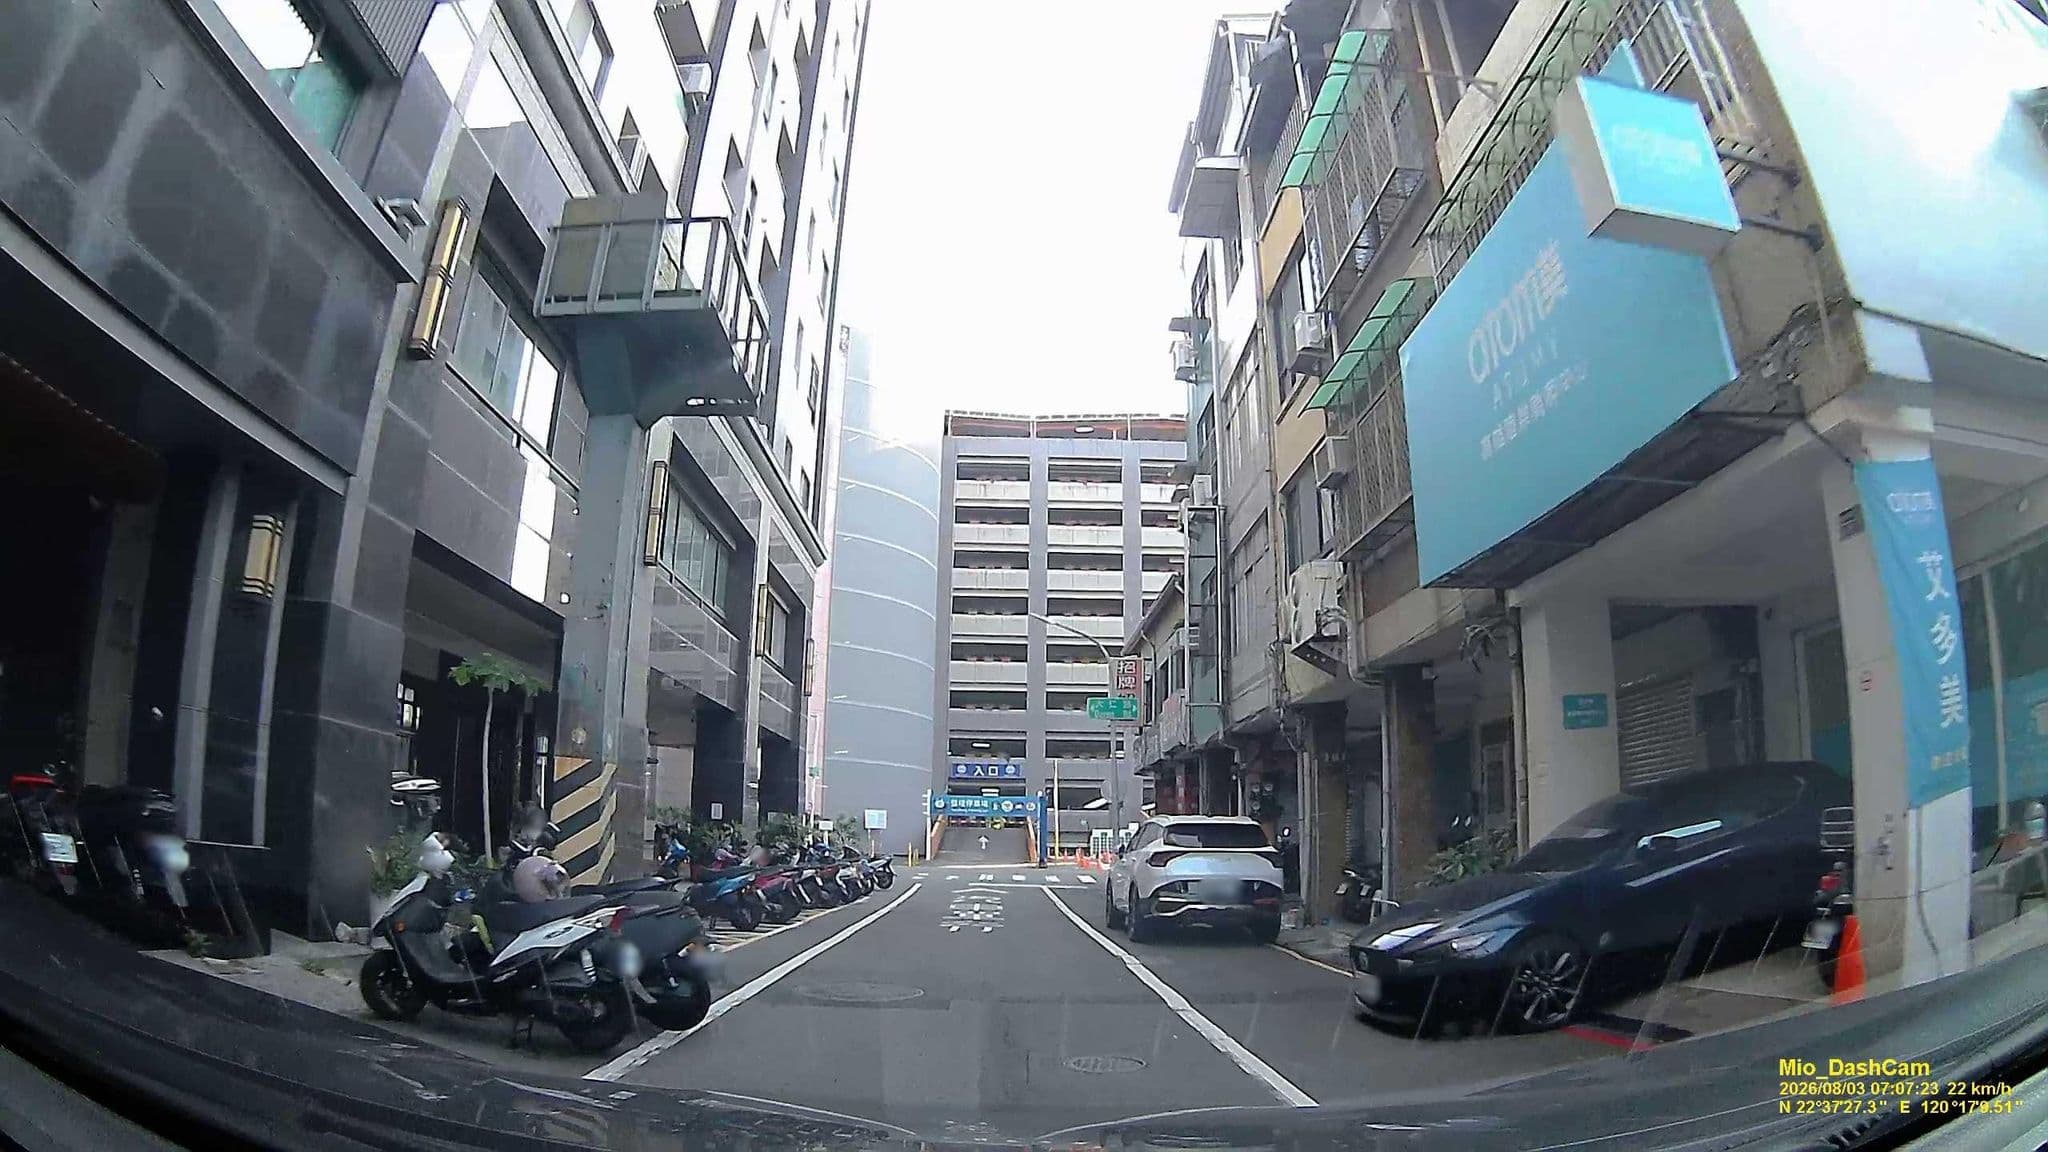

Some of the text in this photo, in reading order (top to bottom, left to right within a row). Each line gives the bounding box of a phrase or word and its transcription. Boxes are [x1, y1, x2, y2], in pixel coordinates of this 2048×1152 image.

[1916, 550, 1964, 730] 艾多美
[974, 765, 999, 776] 入口
